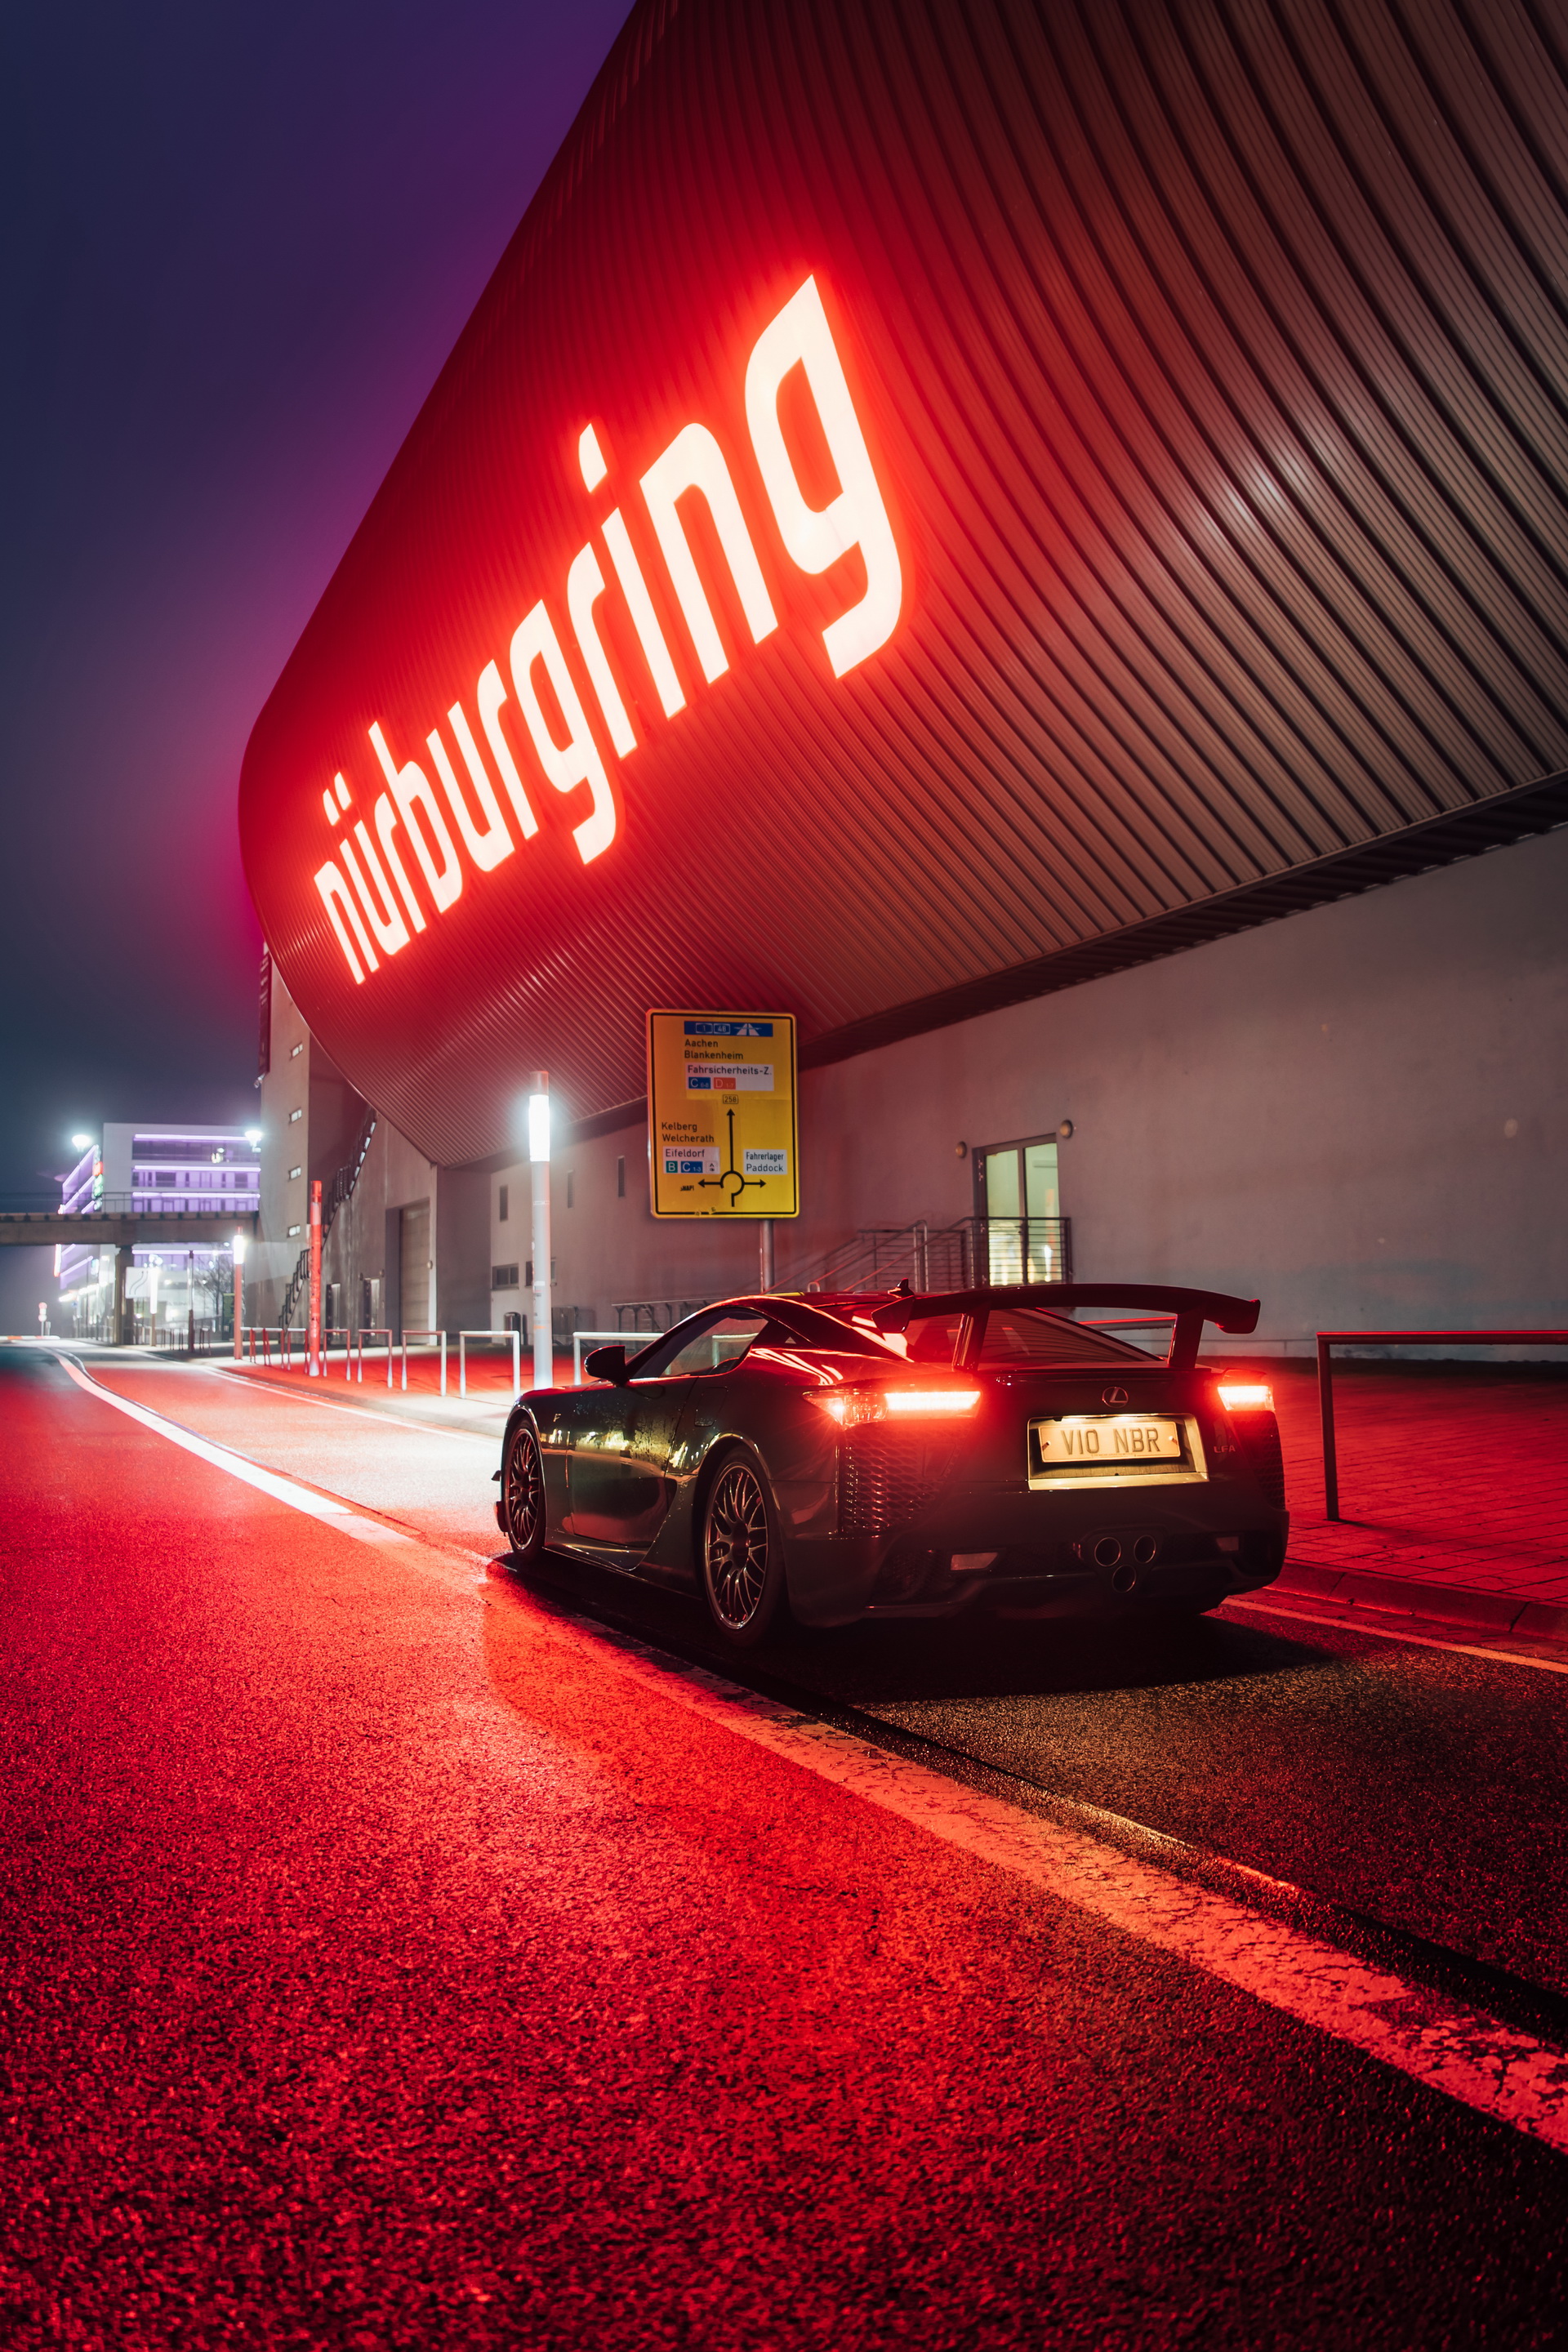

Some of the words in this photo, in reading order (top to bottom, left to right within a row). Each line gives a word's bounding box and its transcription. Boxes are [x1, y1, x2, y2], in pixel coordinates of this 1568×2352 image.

[314, 274, 903, 984] nürburgring
[684, 1039, 719, 1047] Aachen
[684, 1050, 744, 1059] Blankenheim
[662, 1122, 697, 1133] Kelberg
[662, 1134, 715, 1143] Welcherath
[666, 1148, 705, 1157] Eifeldorf
[746, 1152, 784, 1162] Fahrerlager
[668, 1162, 675, 1171] B
[746, 1163, 784, 1172] Paddock
[1113, 1427, 1161, 1453] NBR
[1213, 1445, 1236, 1454] LFA
